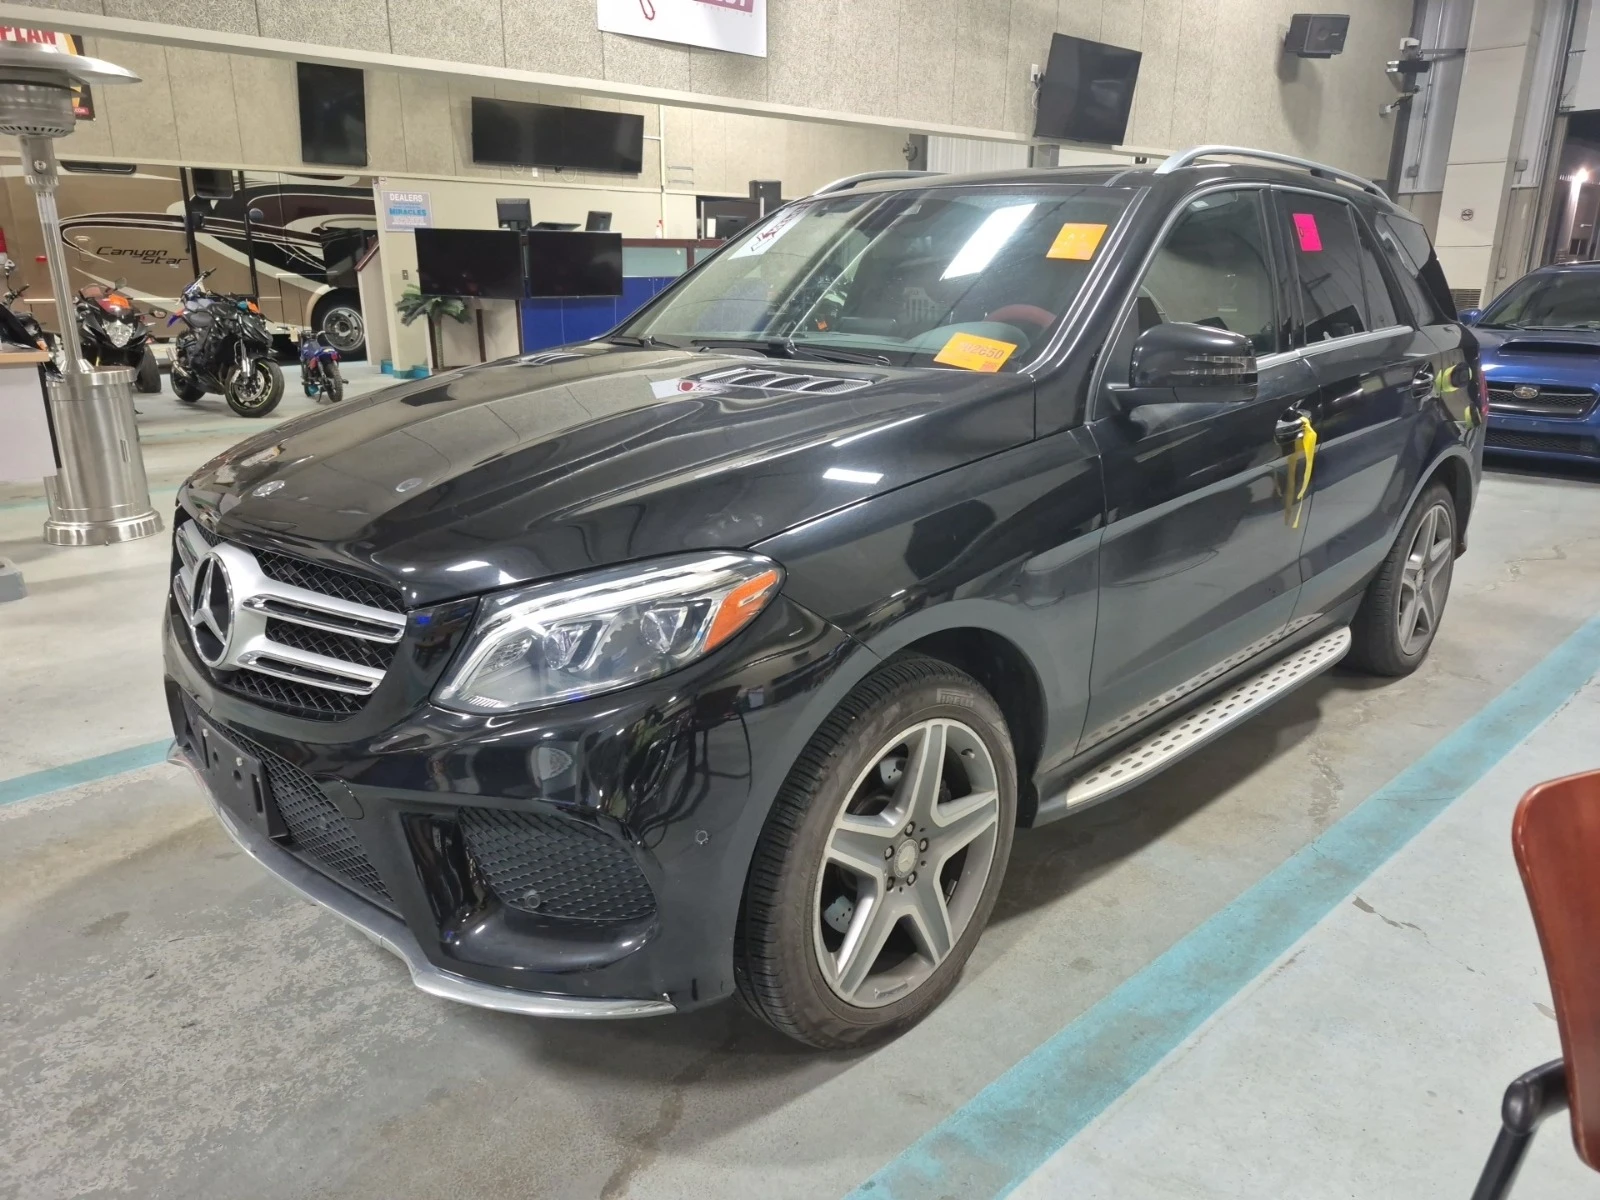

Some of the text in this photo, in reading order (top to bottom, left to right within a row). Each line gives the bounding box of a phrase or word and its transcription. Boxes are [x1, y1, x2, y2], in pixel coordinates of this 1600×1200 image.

[389, 193, 423, 202] DEALERS
[96, 246, 168, 258] Canyon
[140, 256, 188, 264] Star
[936, 688, 974, 707] PIRELLI
